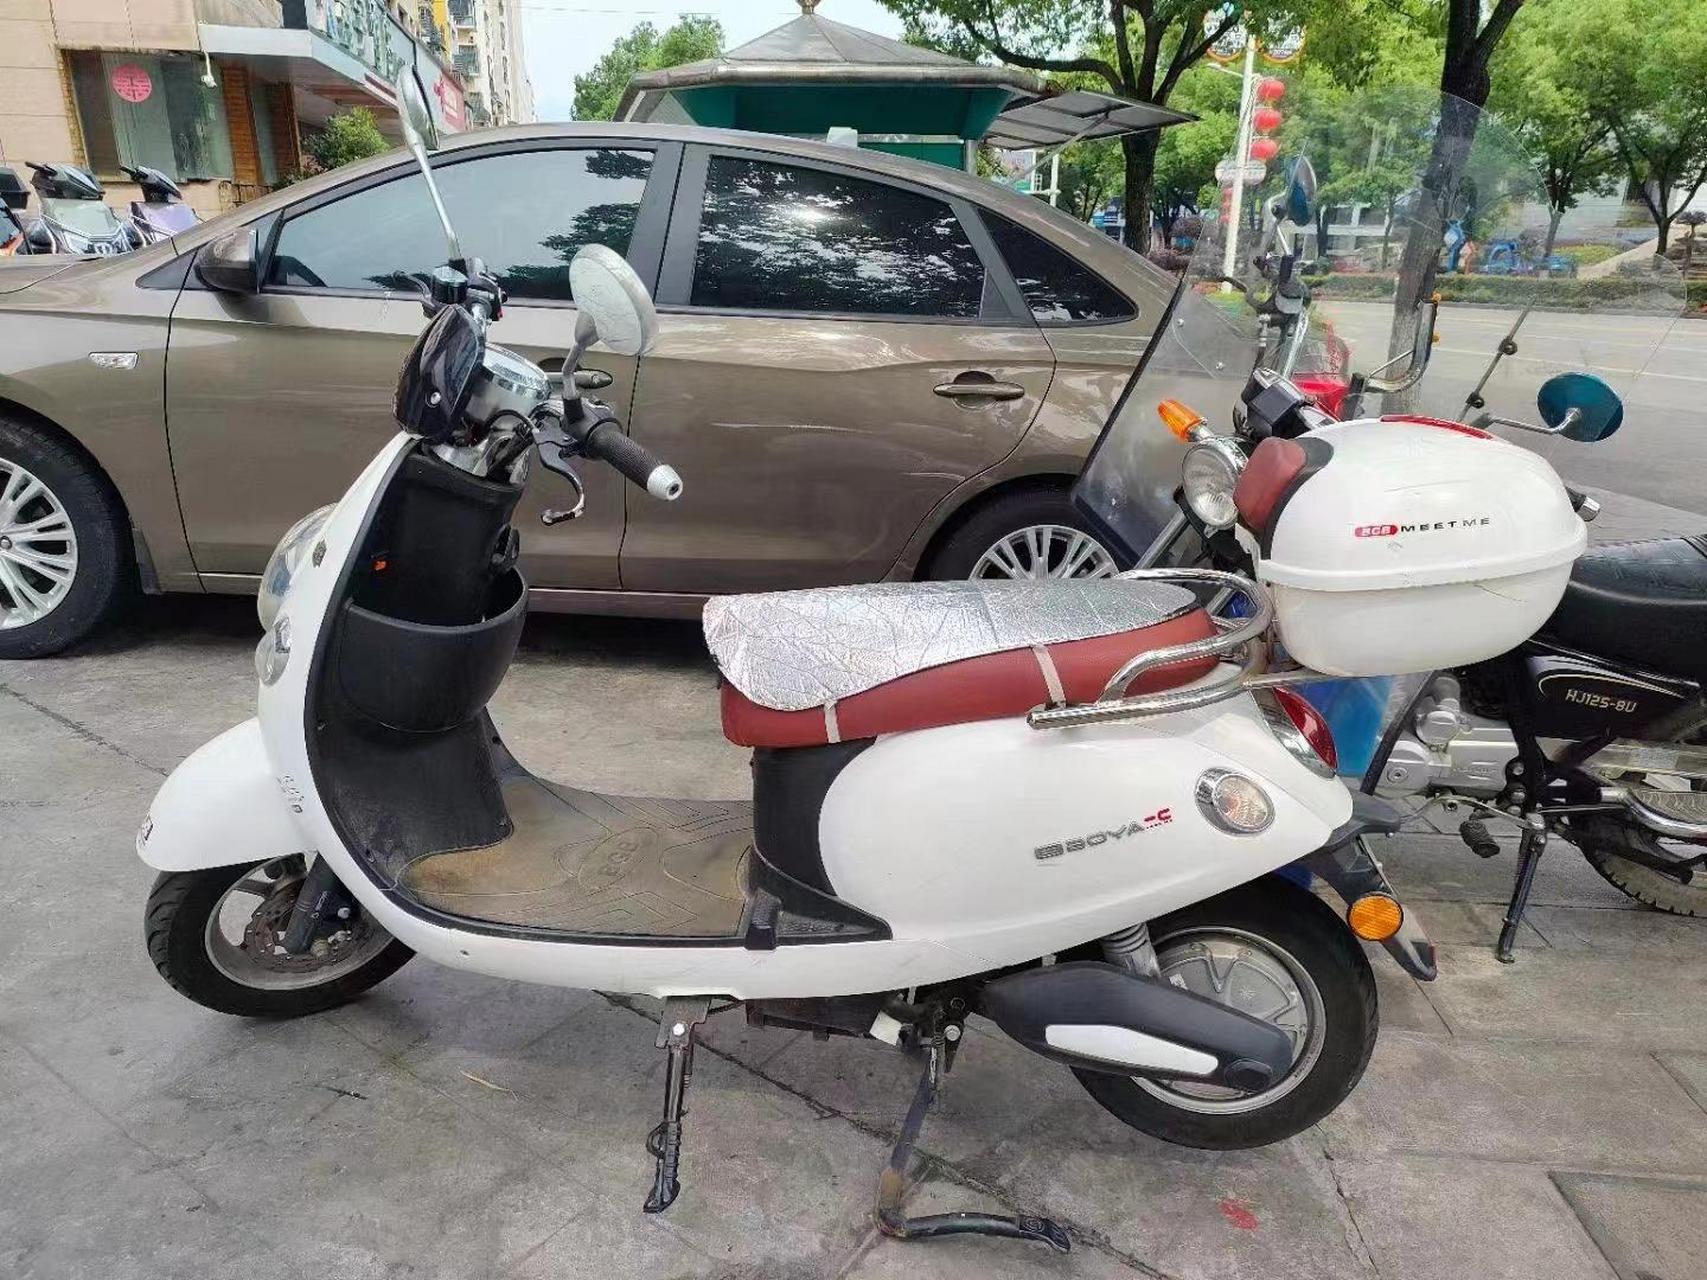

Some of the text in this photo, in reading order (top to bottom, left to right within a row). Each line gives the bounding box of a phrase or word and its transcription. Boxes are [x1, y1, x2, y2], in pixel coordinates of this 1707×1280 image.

[1400, 521, 1457, 532] MEET
[1463, 517, 1490, 527] ME
[1565, 689, 1638, 713] HJ125-8U
